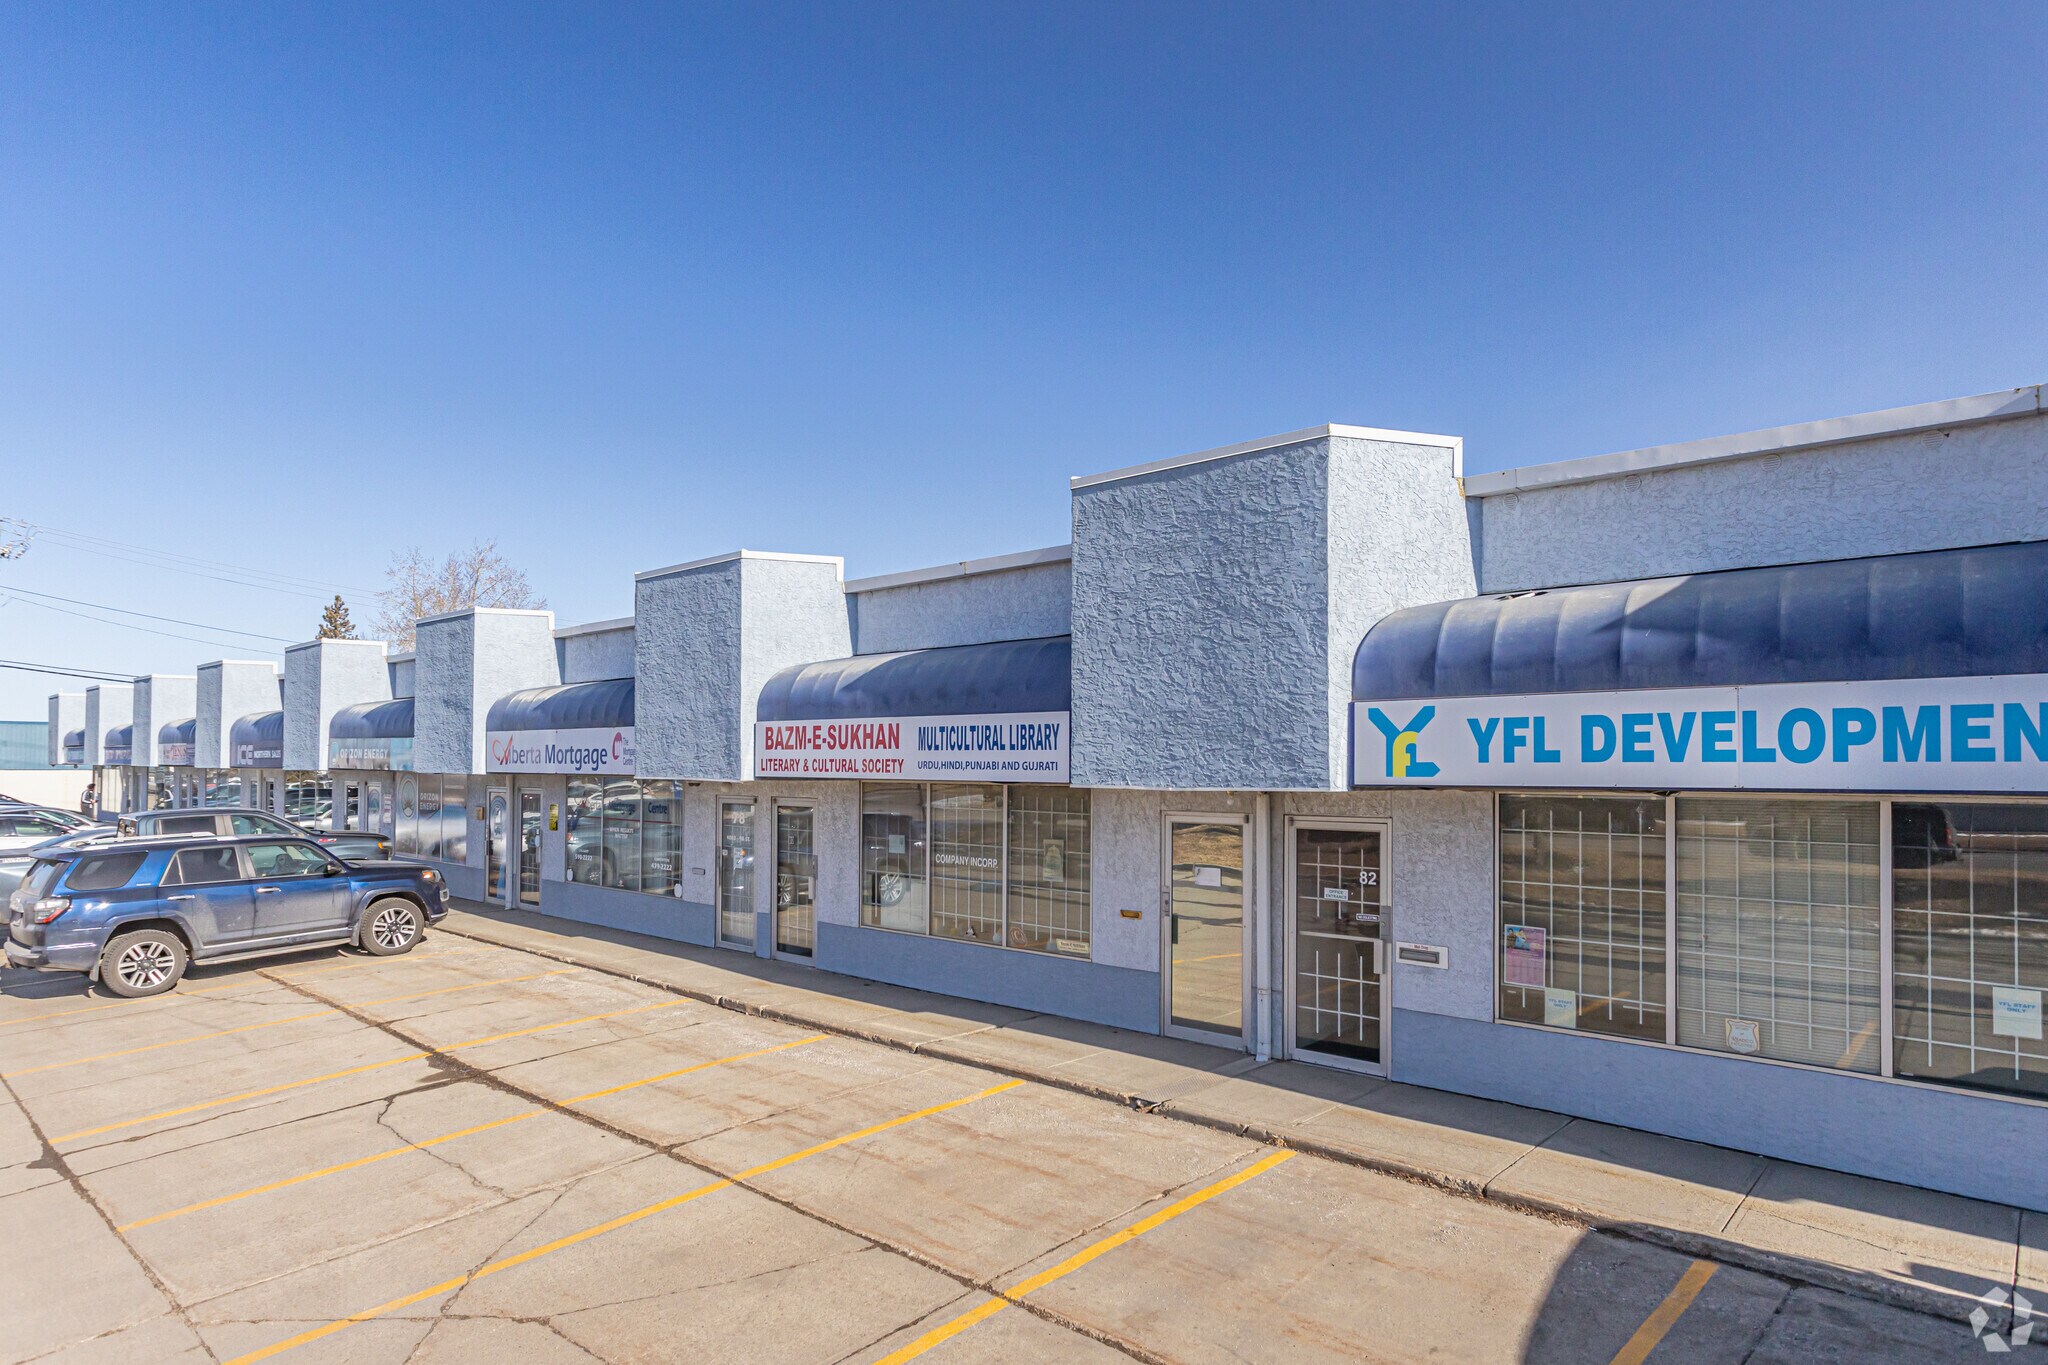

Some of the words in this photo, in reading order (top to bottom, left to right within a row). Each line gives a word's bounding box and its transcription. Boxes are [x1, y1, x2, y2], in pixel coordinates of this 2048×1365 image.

[765, 723, 900, 751] BAZM-E-SUKHAN
[918, 724, 1006, 751] MULTICULTURAL
[1009, 723, 1060, 751] LIBRARY
[1466, 715, 1561, 764] YFL
[1580, 702, 2048, 765] DEVELOPMEN
[363, 748, 389, 760] ENERGY
[544, 744, 608, 771] Mortgage
[760, 758, 800, 772] LITERARY
[802, 759, 809, 771] &
[811, 758, 859, 773] CULTURAL
[861, 758, 904, 773] SOCIETY
[917, 760, 1000, 771] URDU,HINDI,PUNJABI
[1001, 761, 1020, 771] AND
[1021, 761, 1058, 771] GUJRATI
[419, 793, 440, 801] ORIZON
[419, 802, 440, 811] ENERGY
[647, 802, 669, 815] Centre
[731, 812, 746, 824] 78
[935, 854, 969, 865] COMPANY
[970, 857, 998, 868] INCORP.
[1359, 871, 1377, 886] 82
